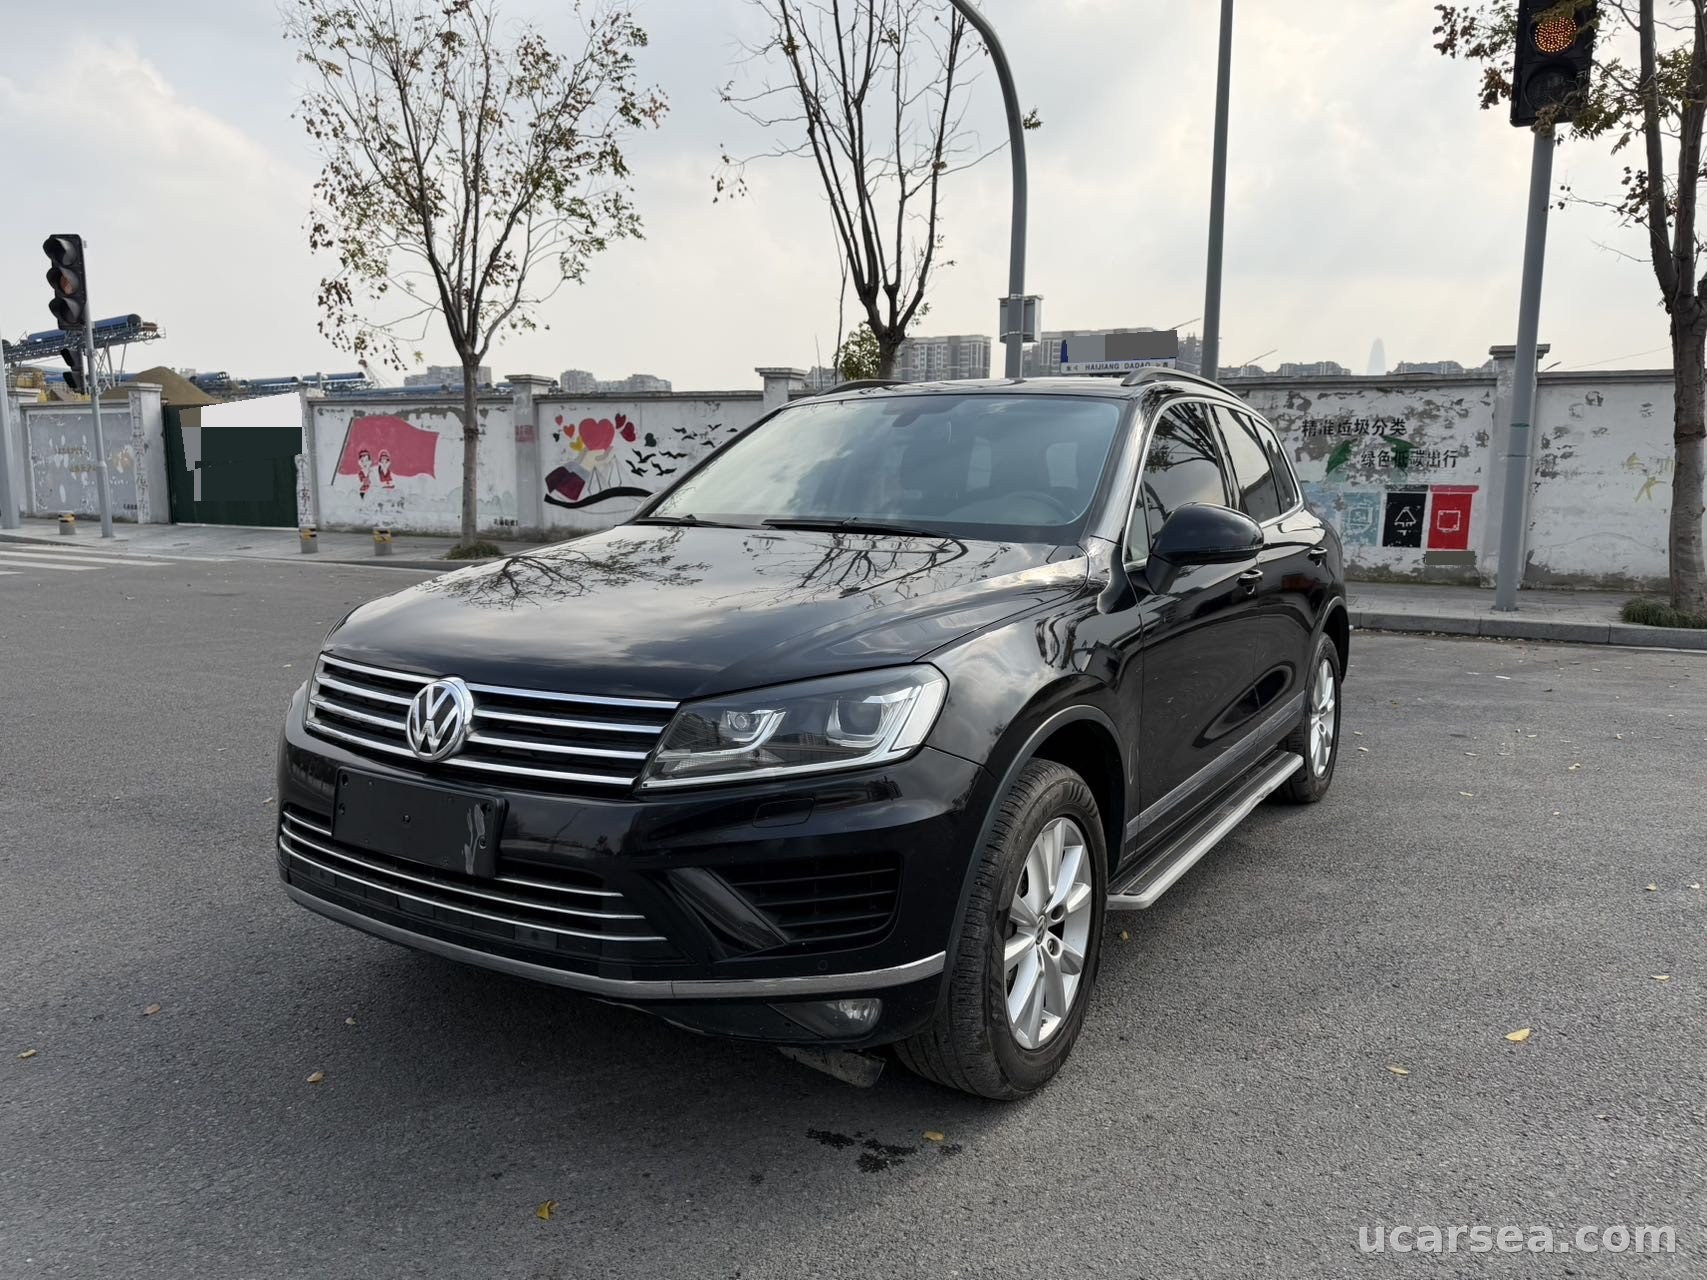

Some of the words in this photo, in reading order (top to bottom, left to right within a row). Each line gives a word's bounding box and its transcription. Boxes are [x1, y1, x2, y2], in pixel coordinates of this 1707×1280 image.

[1085, 362, 1120, 371] HAIJIANG
[1124, 361, 1151, 370] DADAO
[1301, 417, 1407, 437] 精准垃圾分类
[1361, 449, 1459, 468] 绿色低碳出行
